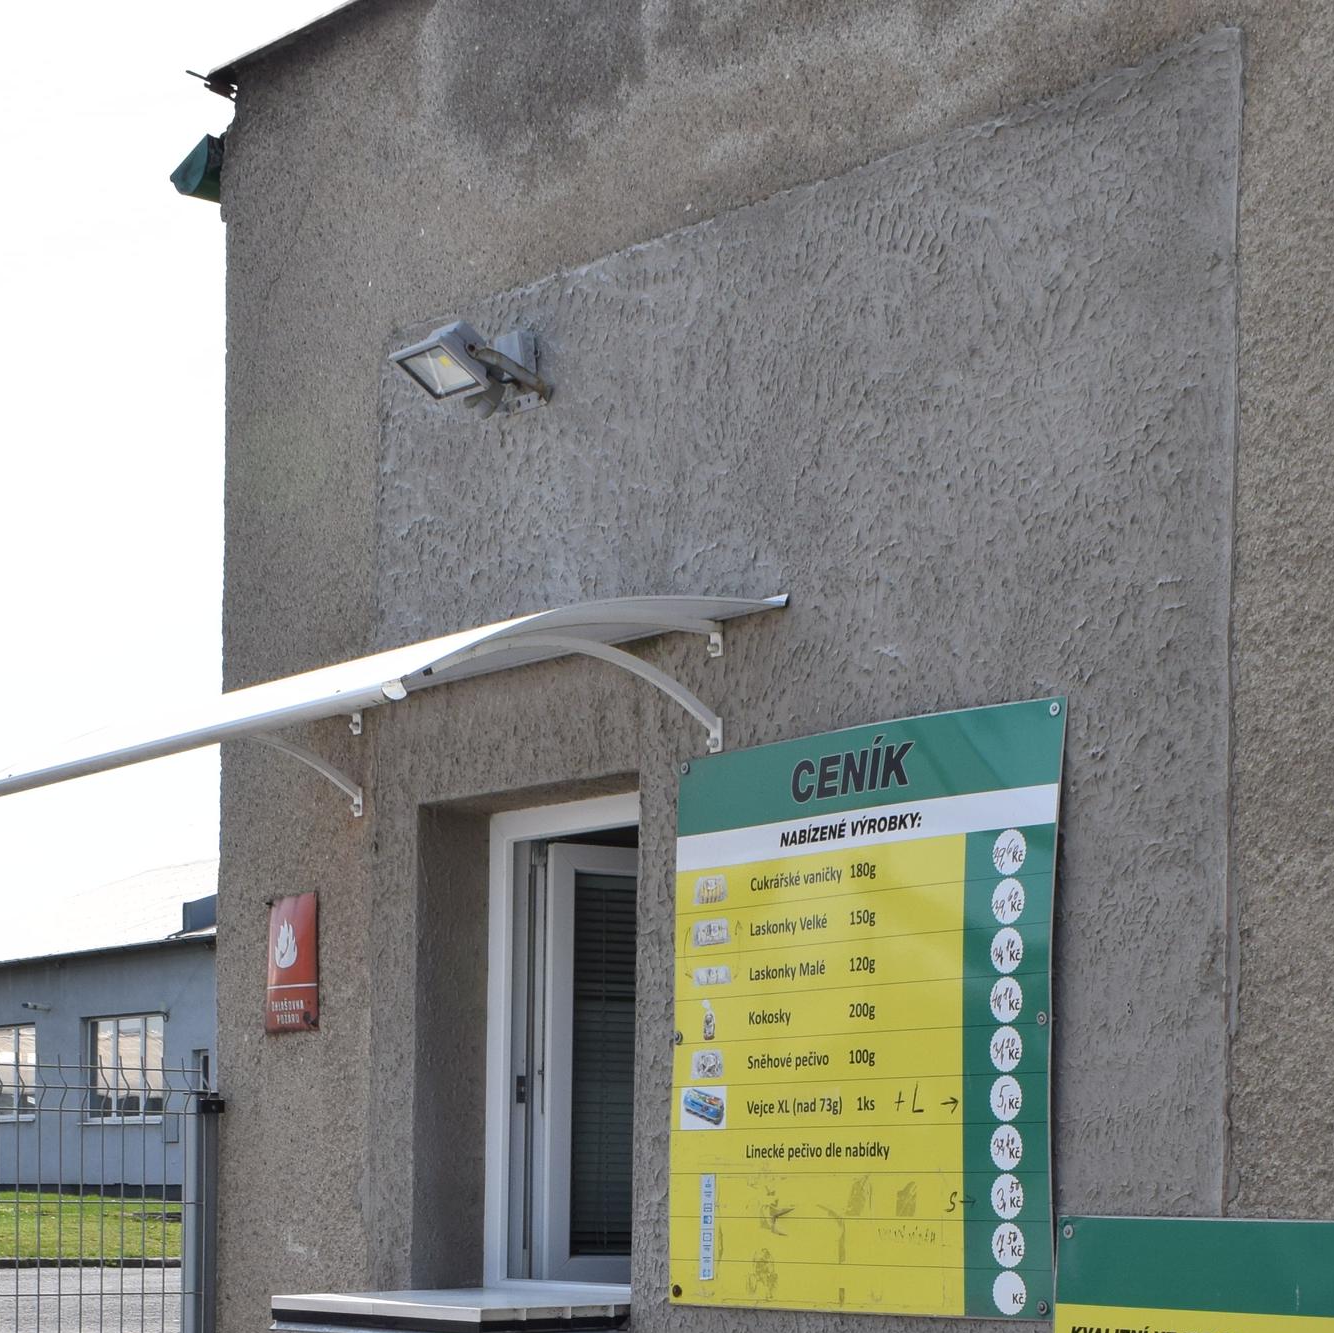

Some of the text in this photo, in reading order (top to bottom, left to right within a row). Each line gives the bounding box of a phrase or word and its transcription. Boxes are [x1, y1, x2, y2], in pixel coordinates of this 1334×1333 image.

[792, 735, 914, 803] CENÍK
[780, 812, 922, 848] NABÍZENÉ VÝROBKY:
[1012, 850, 1024, 863] Kč
[750, 862, 876, 891] Cukrářské vaničky 180g
[1010, 899, 1022, 912] Kč
[750, 909, 876, 937] Laskonky Velké 150g
[1009, 949, 1021, 962] Kč
[749, 956, 876, 981] Laskonky Malé 120g
[1008, 998, 1020, 1011] Kč
[748, 1002, 876, 1026] Kokosky 200g
[747, 1049, 876, 1071] Sněhové pečivo 100g
[1008, 1047, 1020, 1060] Kč
[747, 1096, 876, 1117] Vejce XL (nad 73g) 1ks
[1008, 1097, 1020, 1110] Kč
[746, 1142, 890, 1161] Linecké pečivo dle nabídky
[1009, 1147, 1020, 1159] Kč
[1009, 1197, 1021, 1208] Kč
[1011, 1244, 1023, 1257] Kč
[1012, 1293, 1024, 1305] Kč
